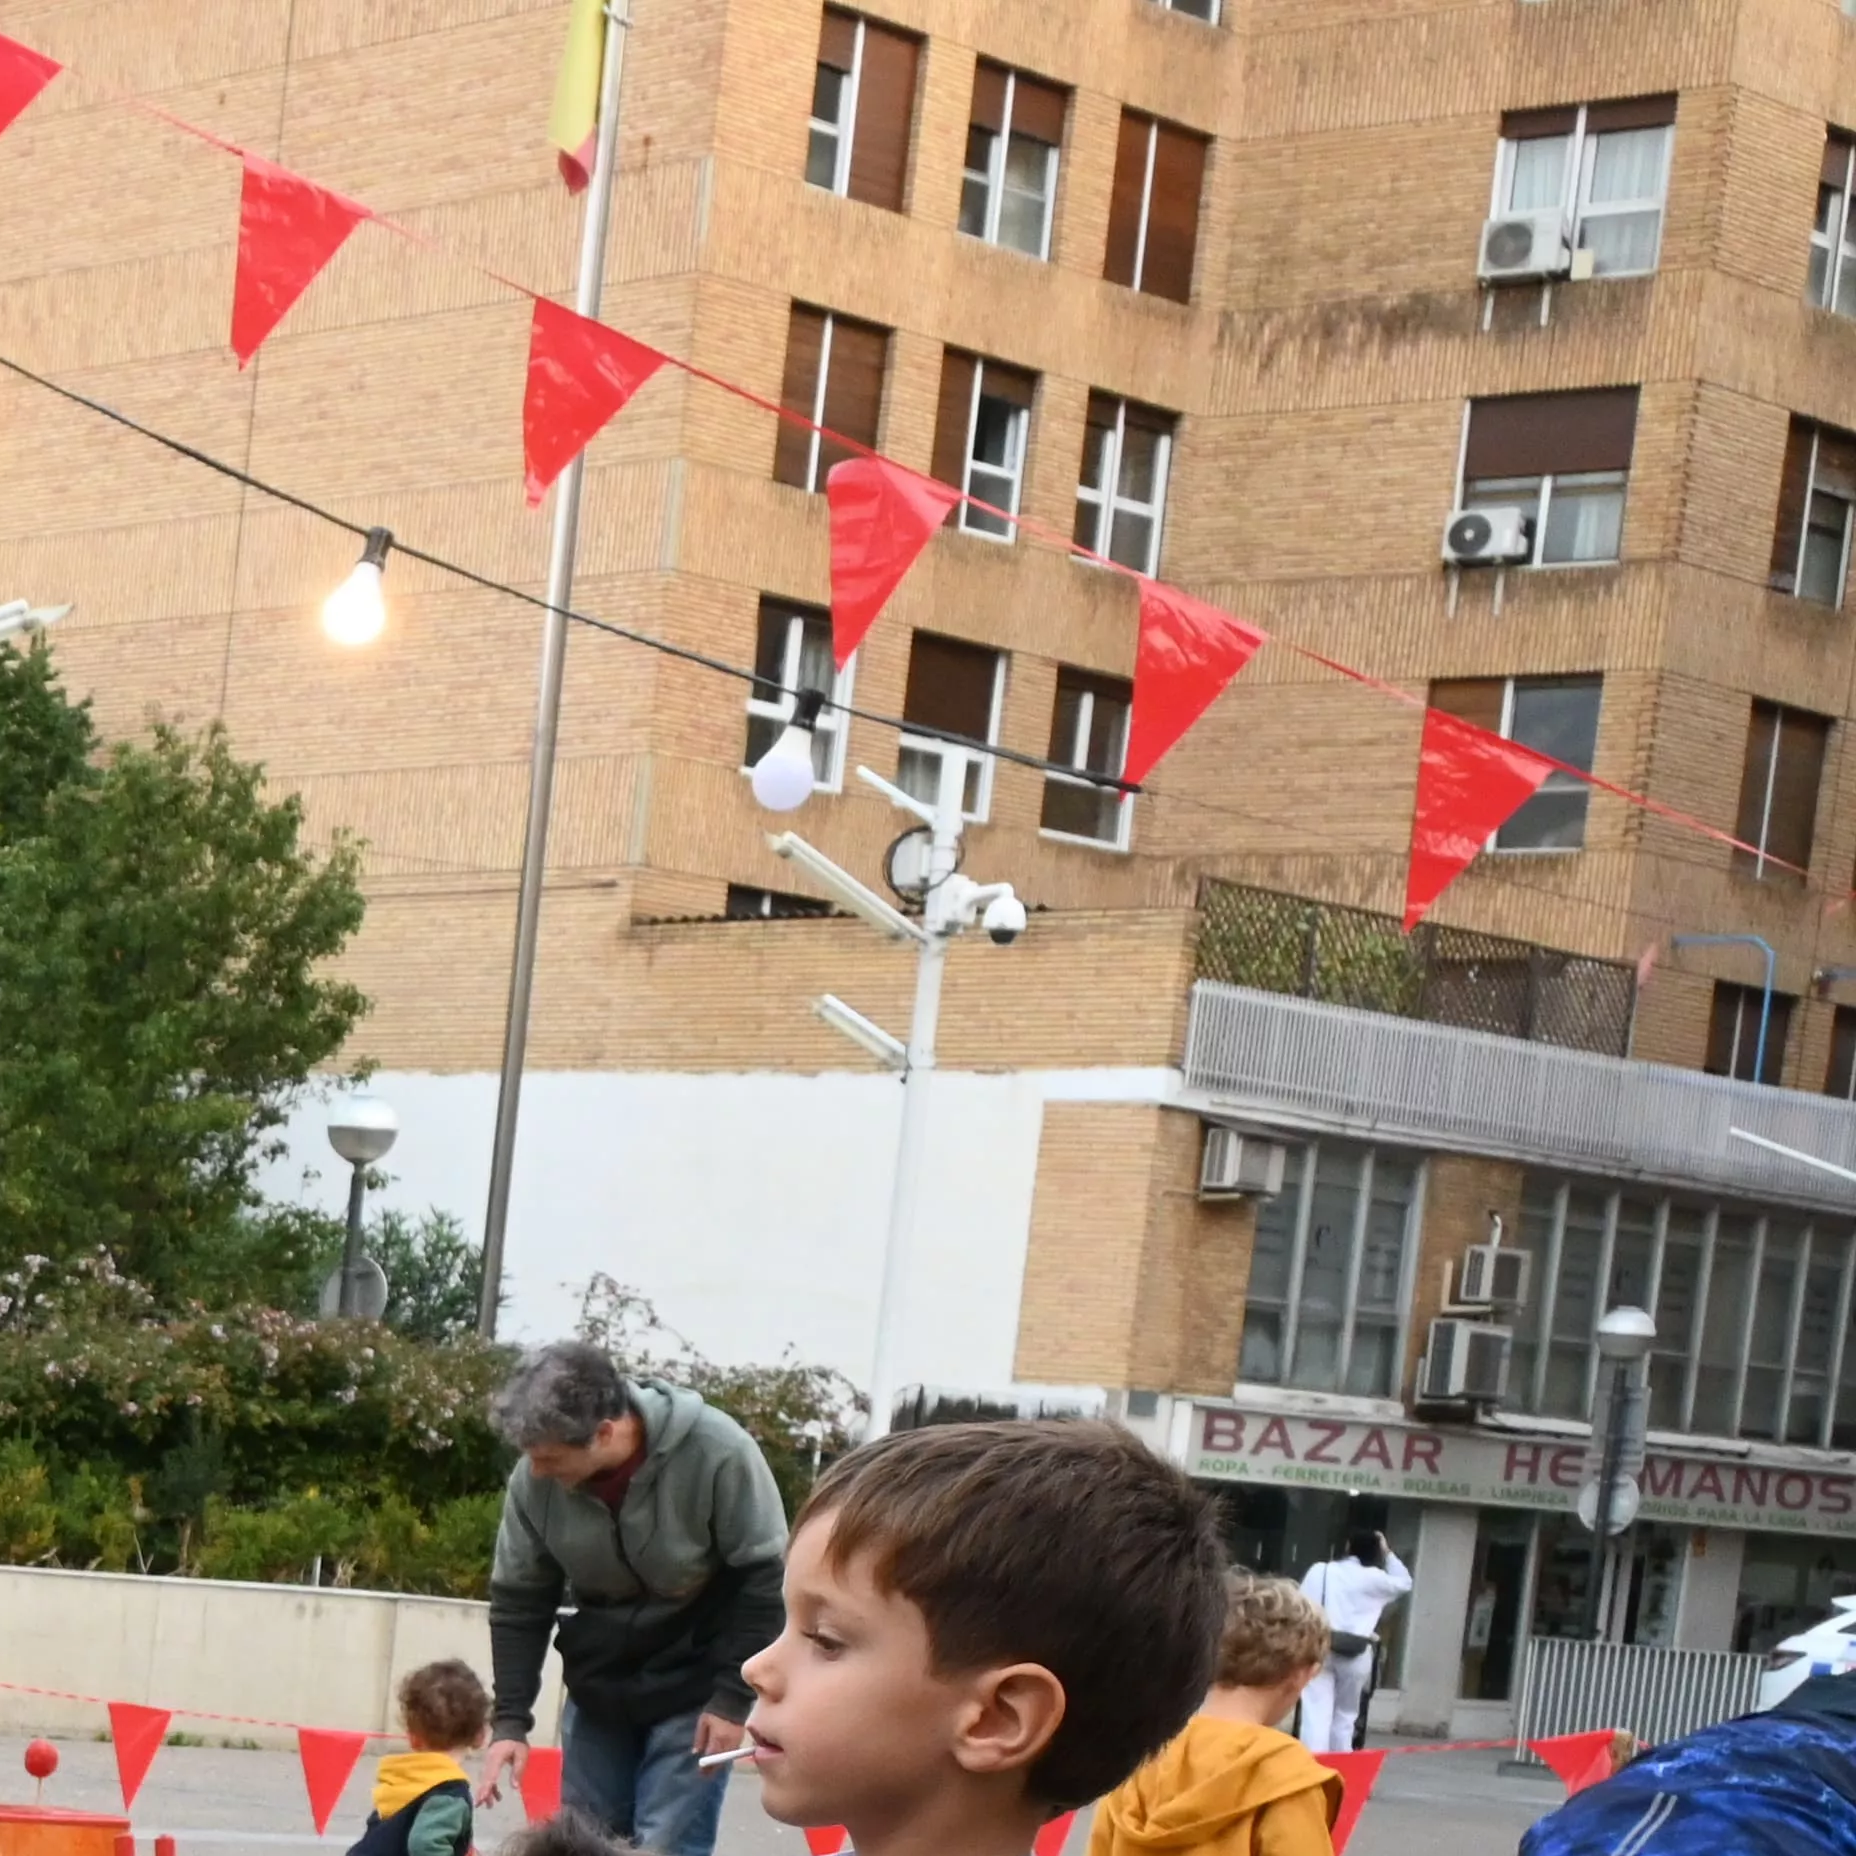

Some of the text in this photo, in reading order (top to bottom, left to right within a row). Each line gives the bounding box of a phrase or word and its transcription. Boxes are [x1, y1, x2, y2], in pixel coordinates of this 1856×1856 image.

[1199, 1458, 1249, 1477] ROPA
[1202, 1410, 1855, 1513] BAZAR HEMANOS
